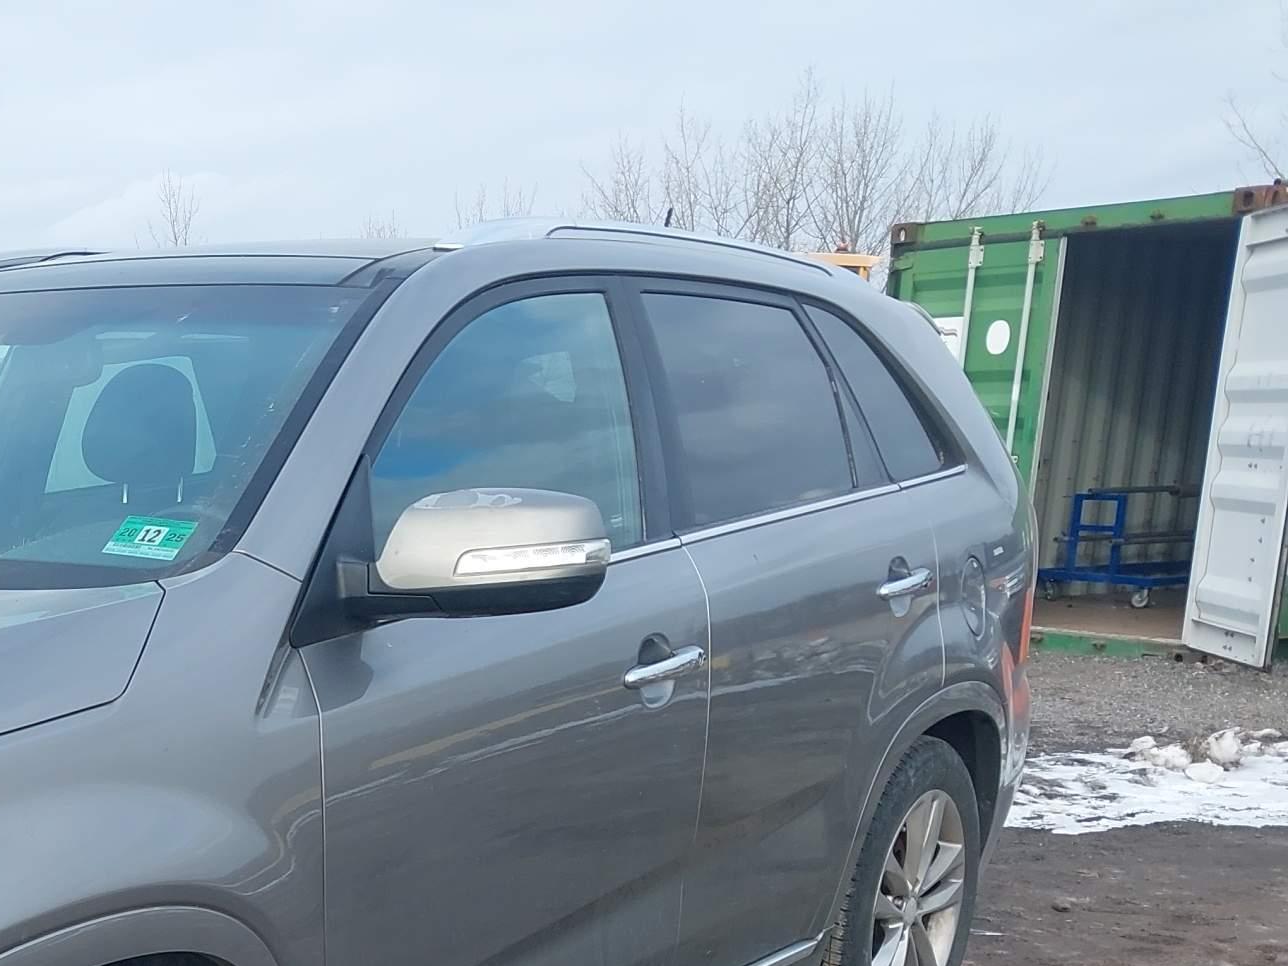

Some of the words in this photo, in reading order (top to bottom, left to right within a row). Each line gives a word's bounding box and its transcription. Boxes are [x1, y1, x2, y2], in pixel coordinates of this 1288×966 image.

[119, 527, 138, 537] 20
[138, 528, 162, 543] 12
[165, 533, 186, 543] 25
